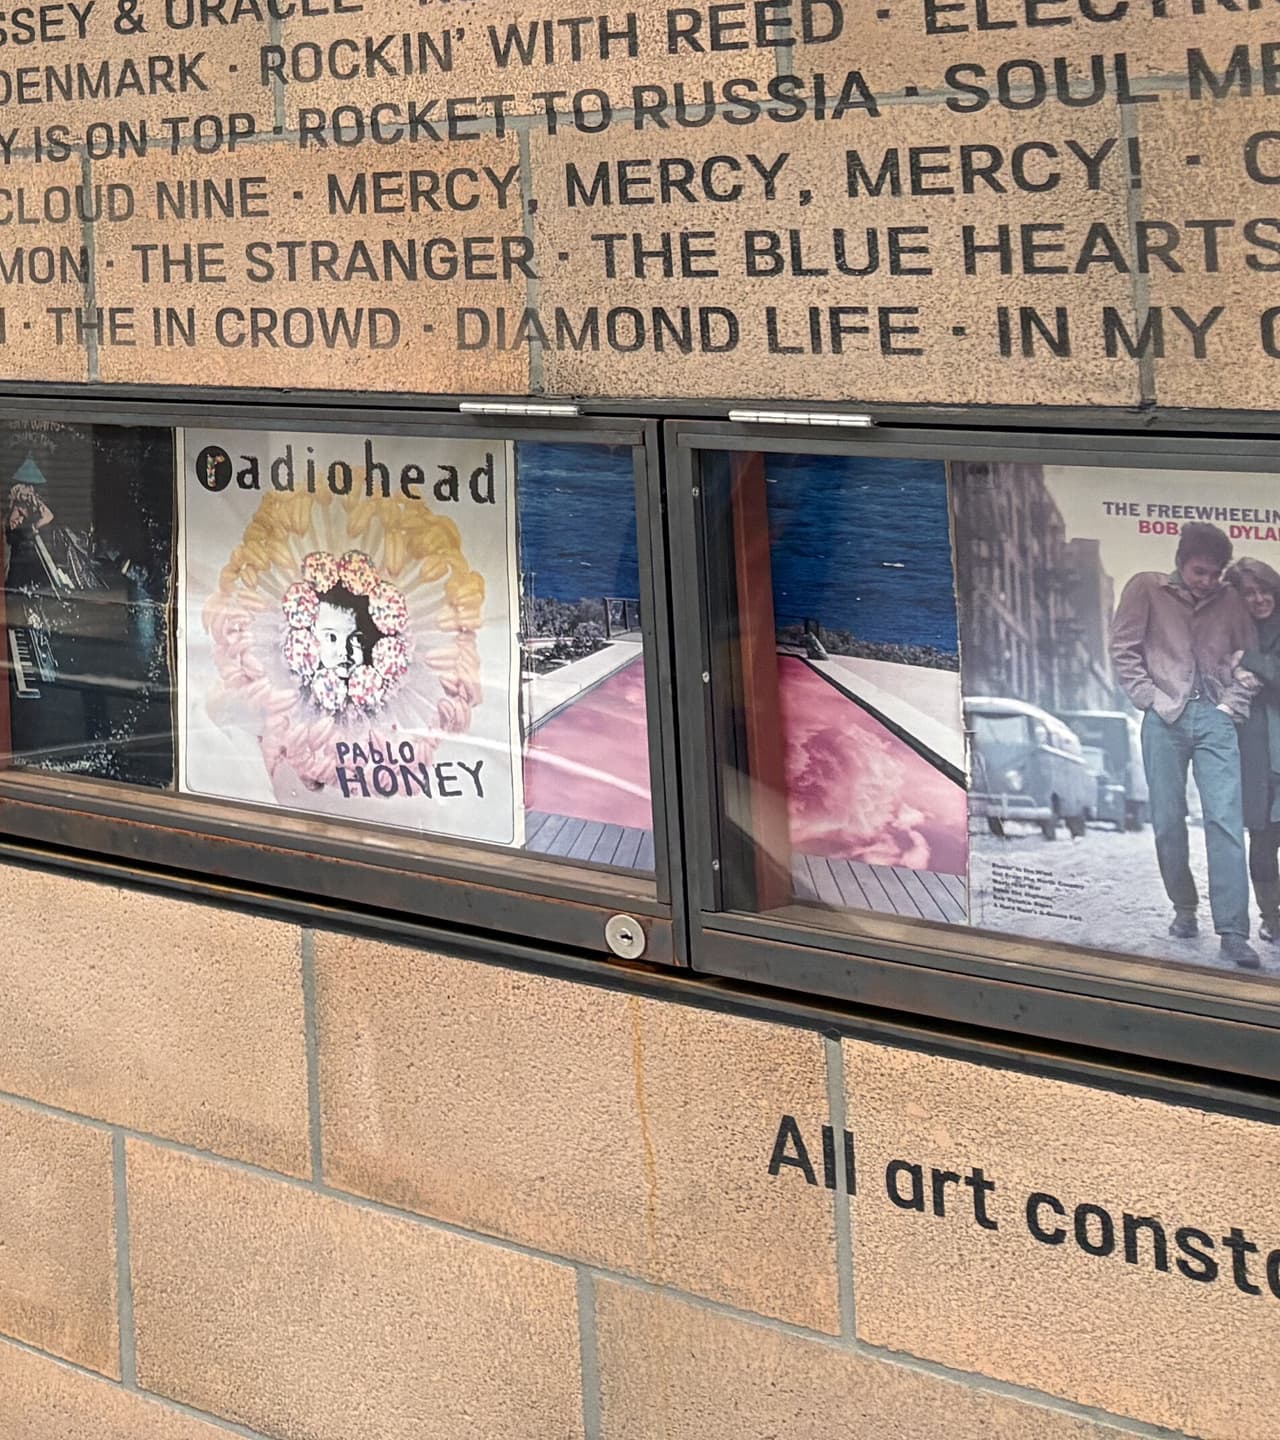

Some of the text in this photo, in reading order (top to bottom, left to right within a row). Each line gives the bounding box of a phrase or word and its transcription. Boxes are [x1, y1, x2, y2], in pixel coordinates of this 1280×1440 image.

[259, 27, 466, 86] ROCKIN'
[487, 12, 639, 69] WITH
[46, 307, 135, 346] THE
[152, 307, 196, 346] IN
[214, 307, 408, 349] CROWD
[455, 306, 740, 353] DIAMOND
[765, 306, 923, 355] LIFE
[996, 306, 1071, 359] IN
[1100, 306, 1226, 358] MY
[196, 438, 496, 505] radiohead
[1103, 501, 1140, 516] THE
[1139, 520, 1280, 542] BOB DYLA
[336, 760, 484, 799] HONEY
[768, 1115, 857, 1195] All
[886, 1159, 998, 1230] art
